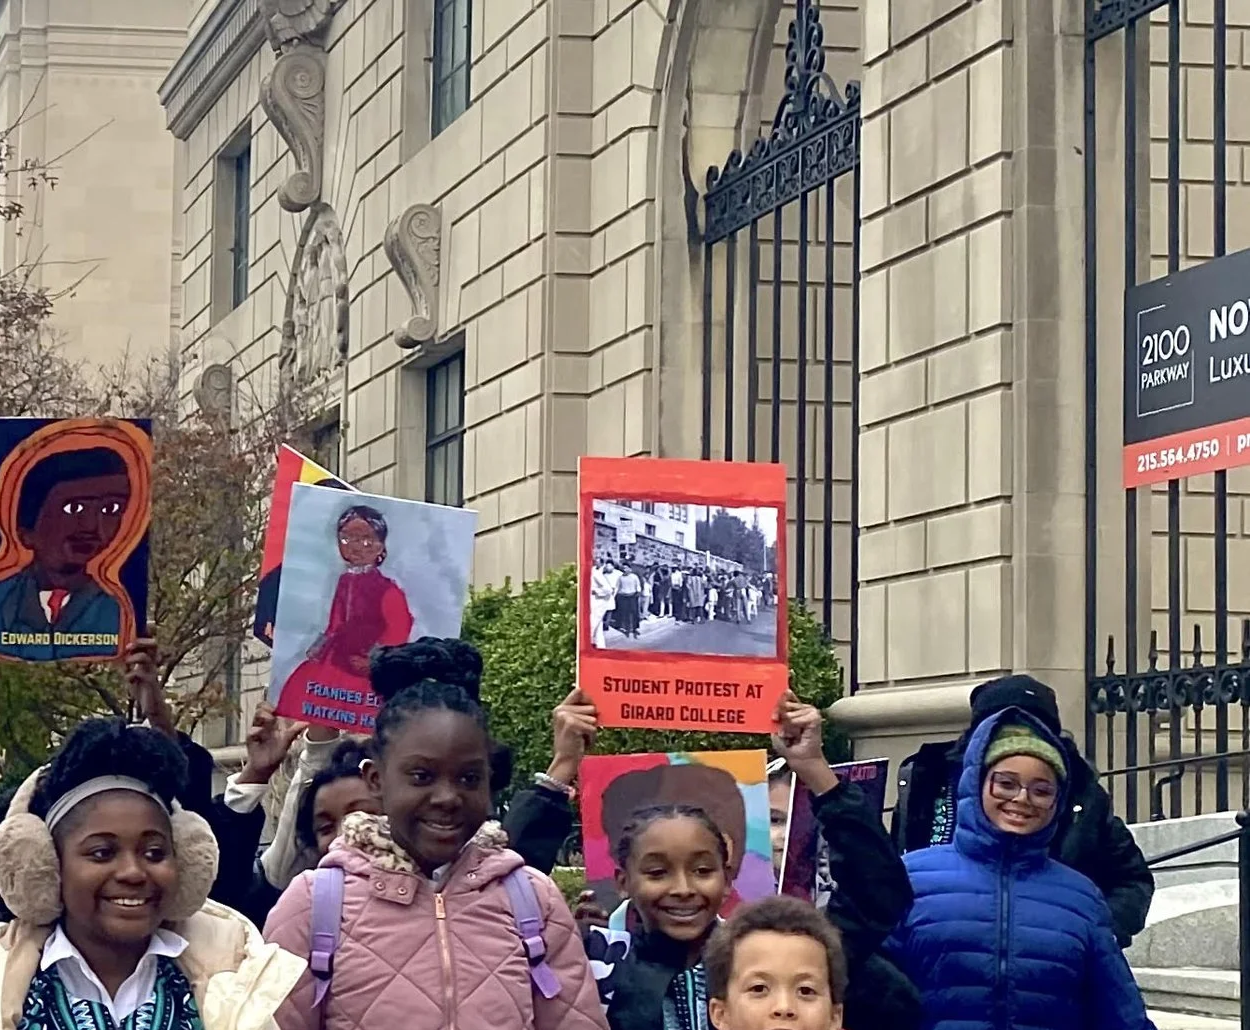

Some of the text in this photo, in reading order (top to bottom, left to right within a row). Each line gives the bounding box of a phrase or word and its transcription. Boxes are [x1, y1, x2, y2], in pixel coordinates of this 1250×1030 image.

[1210, 299, 1250, 343] NO
[1142, 325, 1190, 366] 2100
[1141, 361, 1190, 389] PARKWAY
[1137, 438, 1219, 473] 215.564.4750
[1, 632, 50, 645] EDWARD
[53, 632, 119, 646] DICKERSON
[306, 681, 382, 708] FRANCES EL
[603, 676, 764, 699] STUDENT PROTEST AT
[302, 701, 376, 727] WATKINS HA
[621, 703, 746, 724] GIRARD COLLEGE
